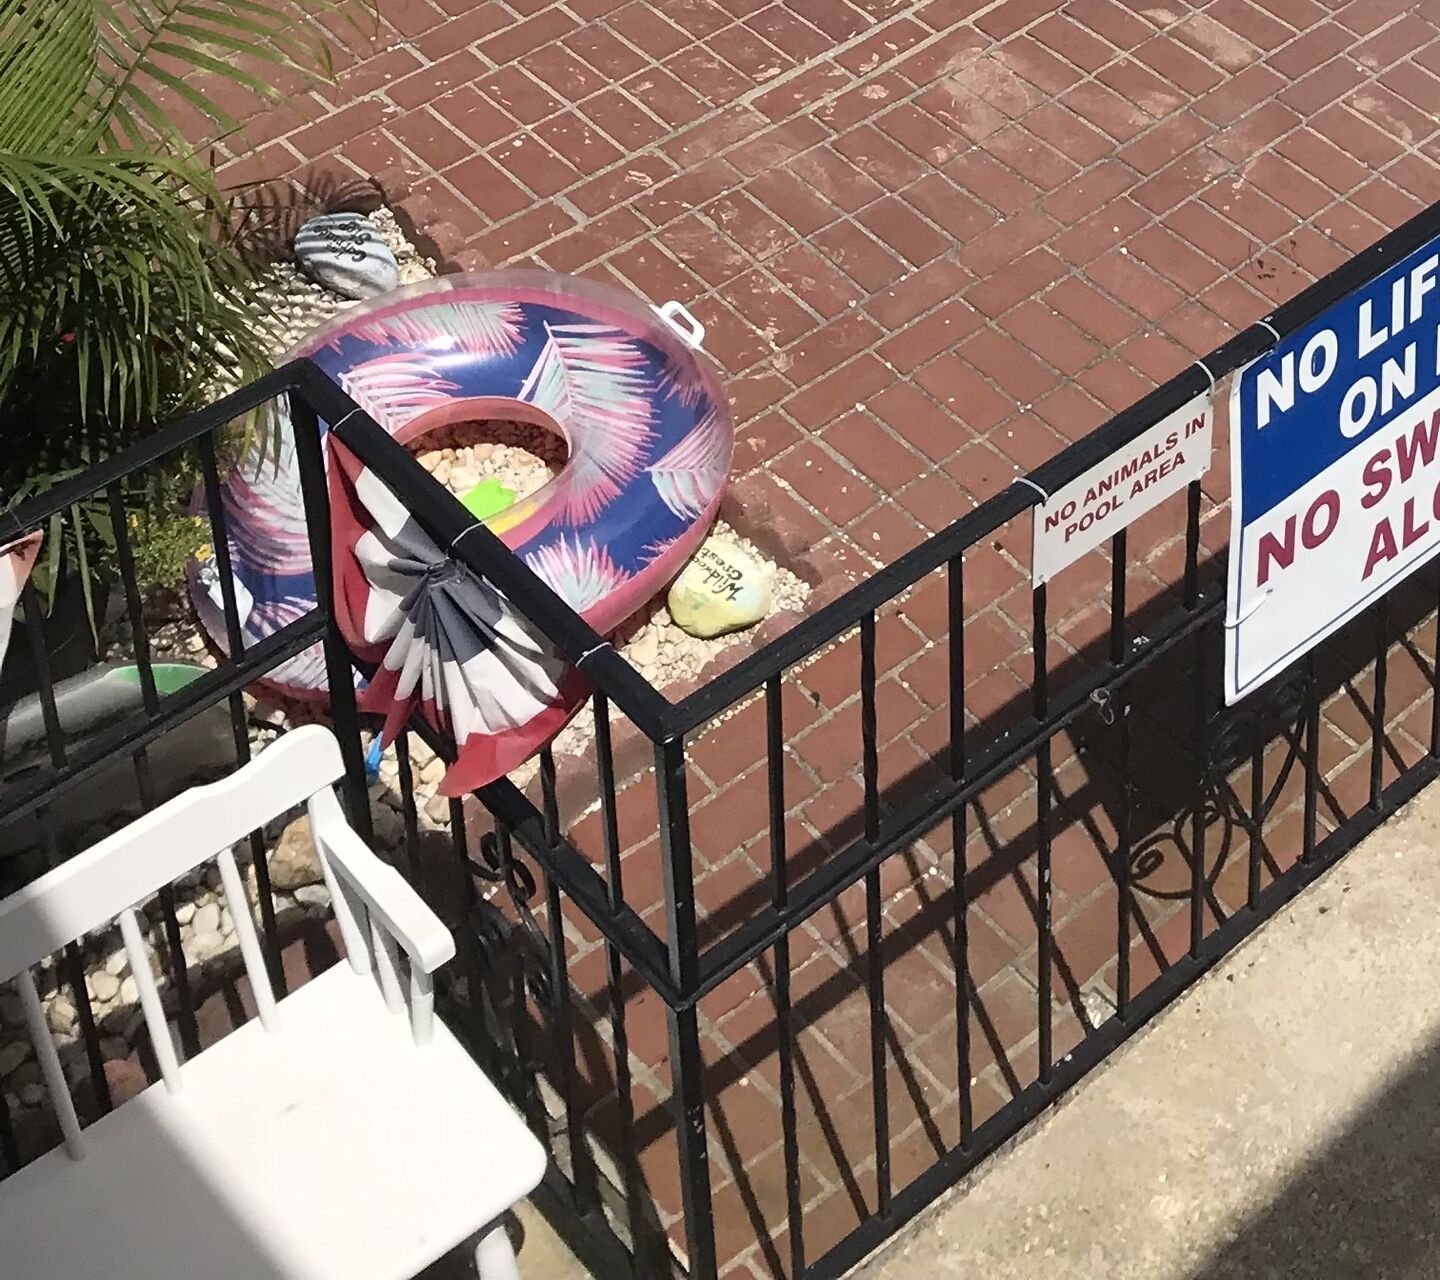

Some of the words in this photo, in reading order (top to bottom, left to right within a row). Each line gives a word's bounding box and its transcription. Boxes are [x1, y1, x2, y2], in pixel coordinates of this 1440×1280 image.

[1257, 329, 1338, 429] NO
[1339, 359, 1416, 438] ON
[1045, 500, 1076, 533] NO
[1083, 431, 1178, 508] ANIMALS
[1185, 413, 1205, 439] IN
[1065, 495, 1123, 543] POOL
[1129, 451, 1185, 500] AREA
[693, 556, 744, 601] Wildwoo
[701, 547, 743, 581] Crest
[1257, 489, 1340, 588] NO
